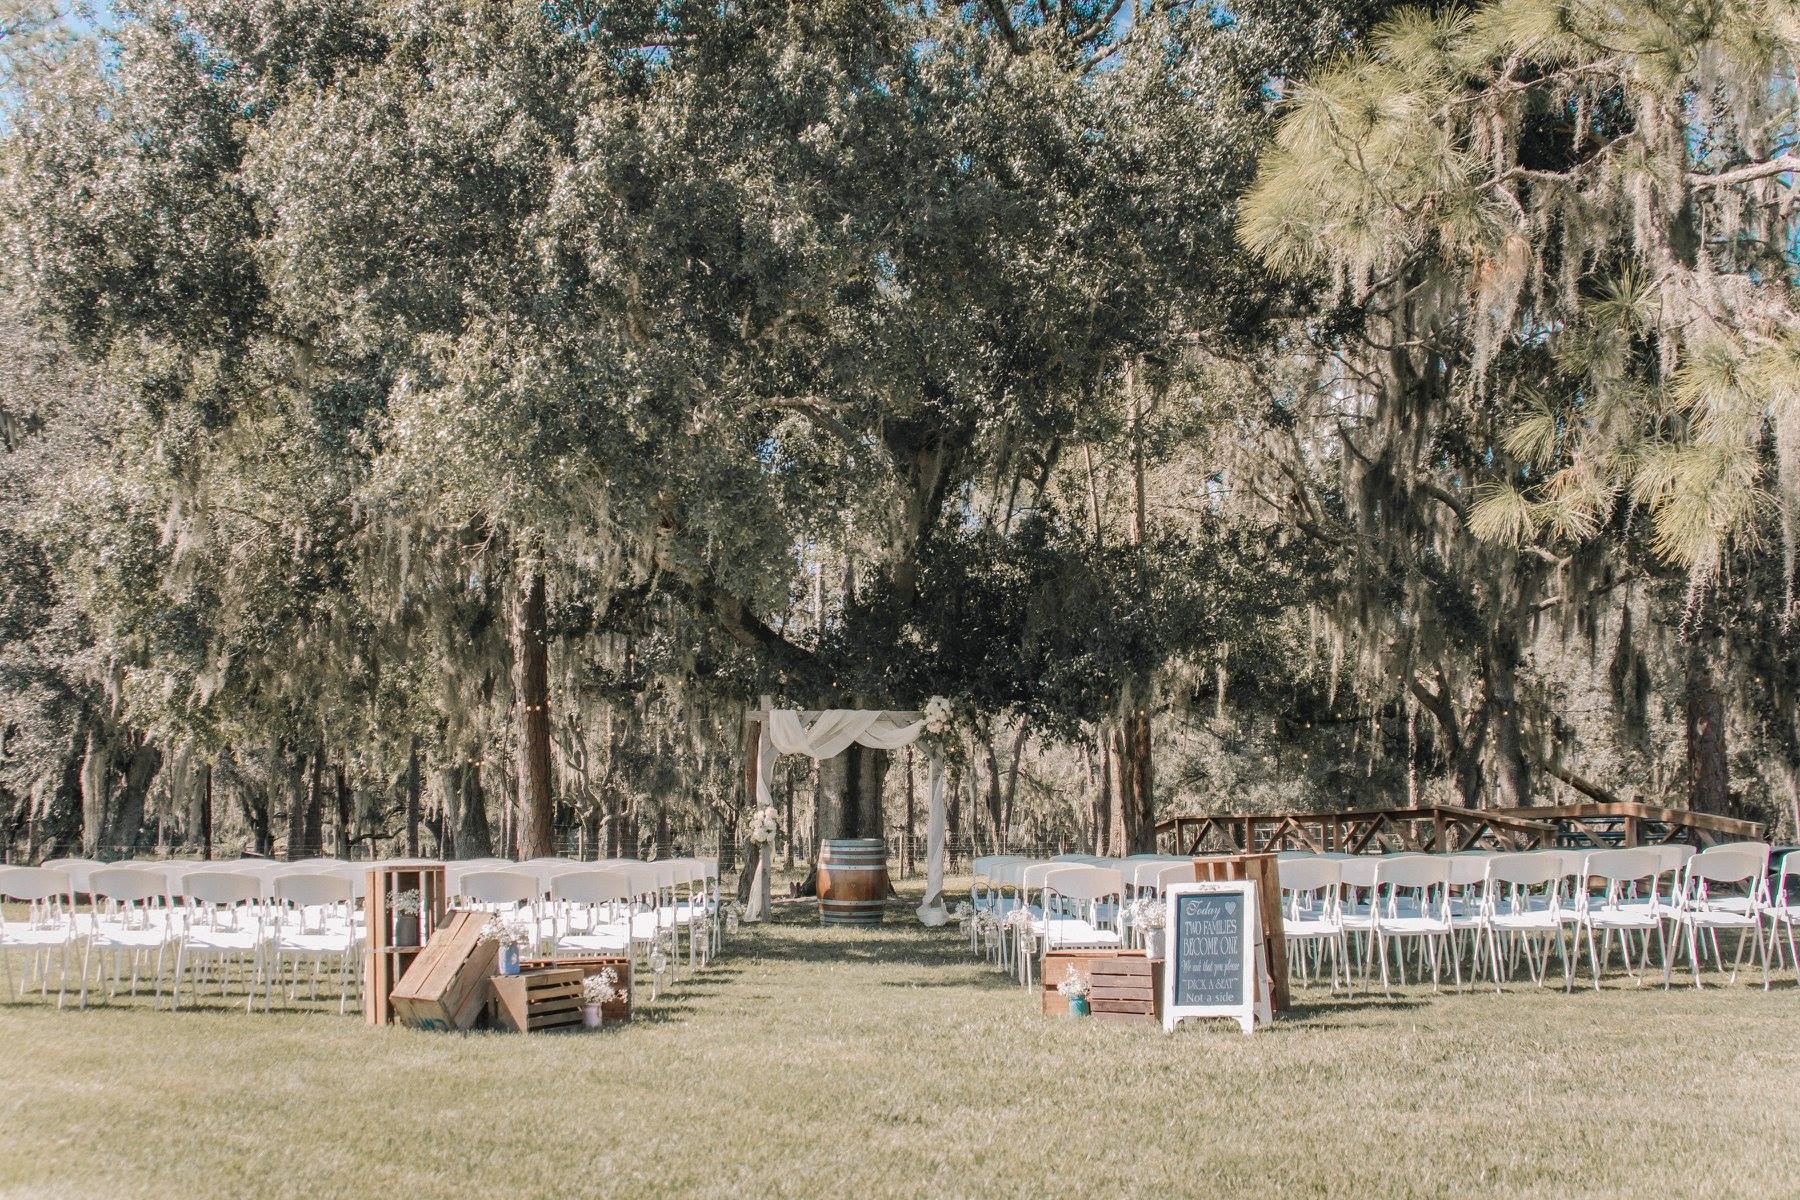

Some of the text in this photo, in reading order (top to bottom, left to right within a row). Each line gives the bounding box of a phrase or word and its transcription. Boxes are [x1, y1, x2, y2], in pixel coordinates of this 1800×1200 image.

[1186, 900, 1220, 920] Today
[1184, 920, 1237, 935] TWO FAMILIES
[1183, 936, 1238, 955] BECOME ONE
[1202, 960, 1213, 971] that
[1208, 979, 1214, 989] A
[1186, 993, 1203, 1002] Not
[1215, 992, 1235, 1002] side
